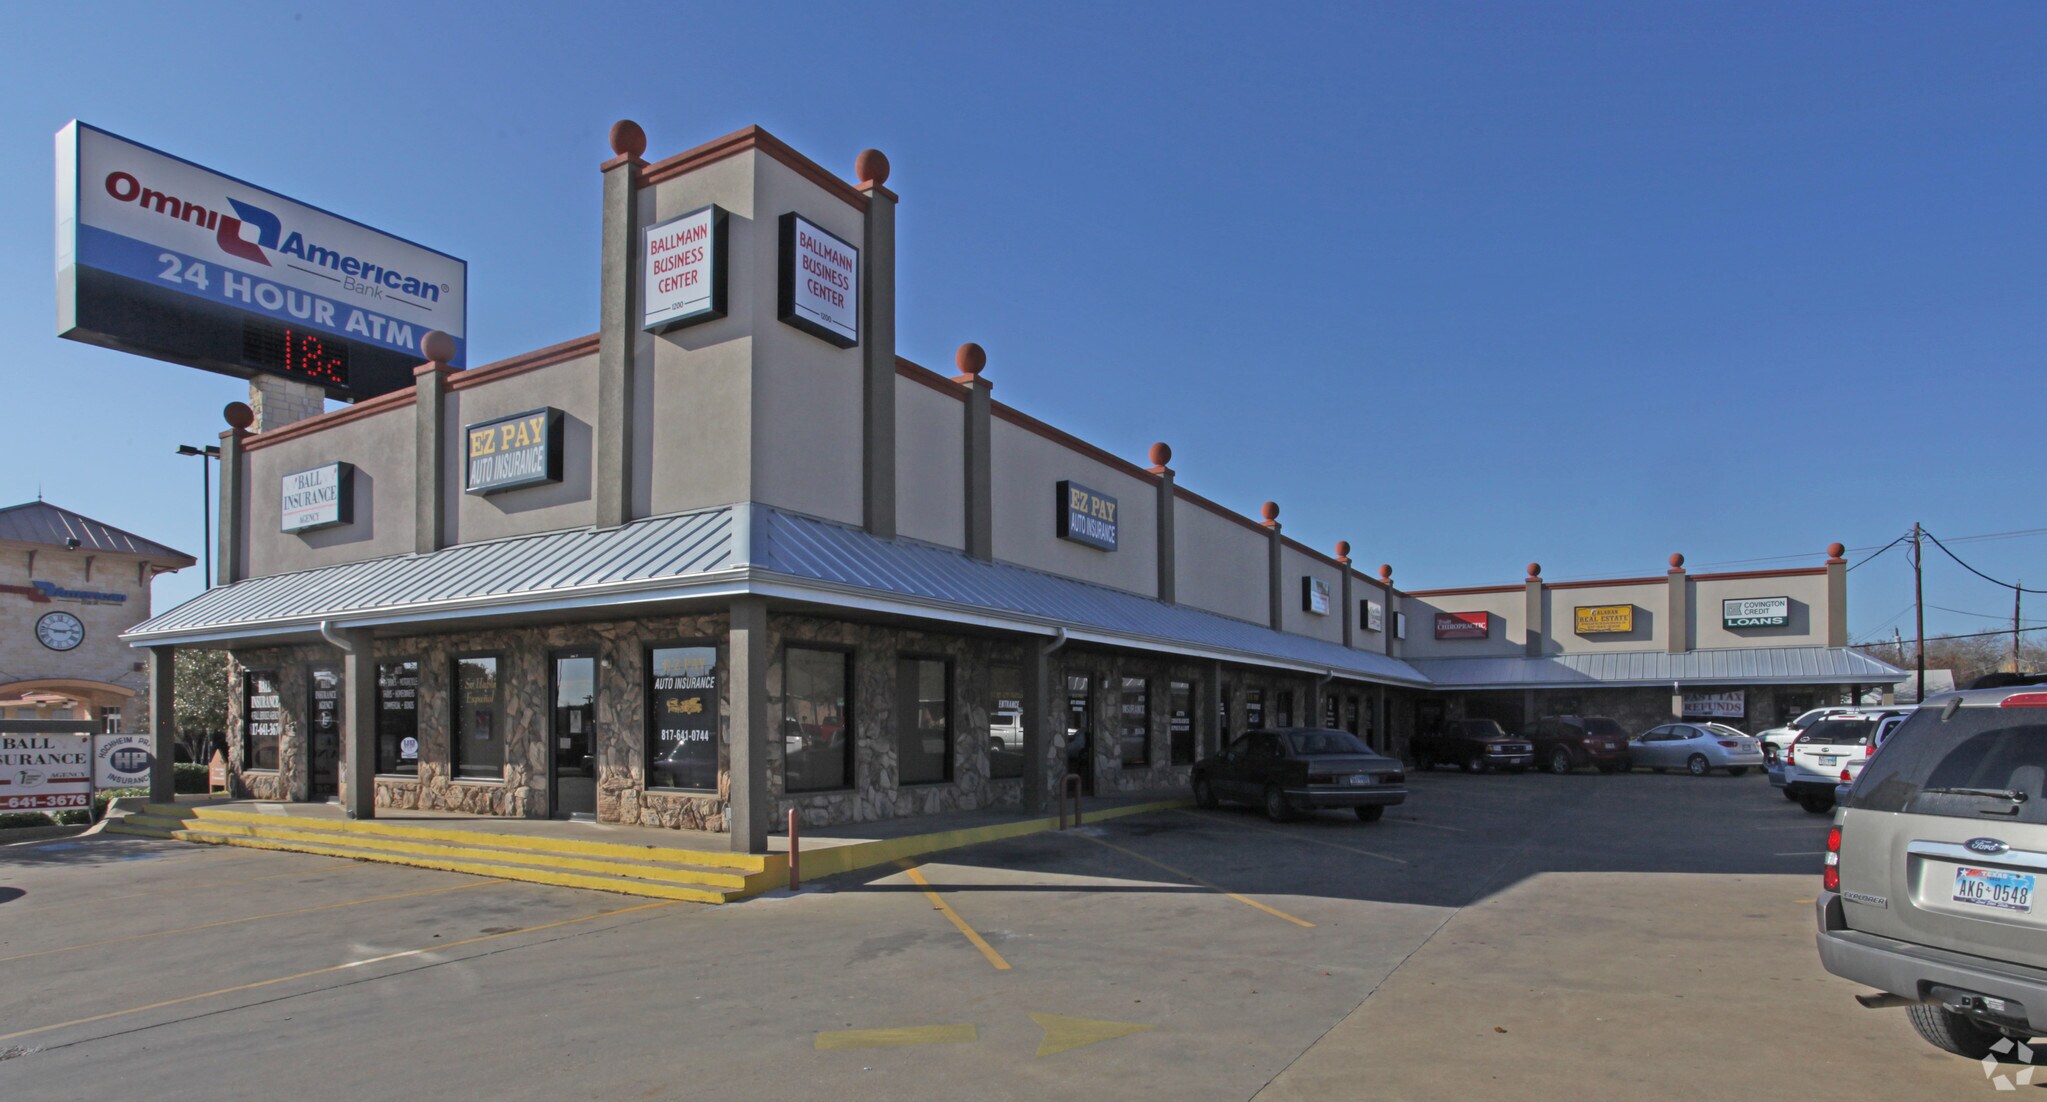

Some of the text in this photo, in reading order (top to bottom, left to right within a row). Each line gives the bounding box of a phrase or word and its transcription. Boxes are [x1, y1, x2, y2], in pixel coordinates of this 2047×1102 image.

[105, 171, 439, 302] Omni American
[651, 223, 707, 255] BALLMANN
[653, 246, 704, 276] BUSINESS
[800, 231, 852, 273] BALLMANN
[658, 269, 698, 294] CENTER
[803, 255, 849, 291] BUSINESS
[344, 276, 383, 300] Bank
[807, 279, 844, 308] CENTER
[158, 253, 415, 350] 24 HOUR ATM
[672, 301, 684, 310] 1200
[820, 312, 832, 323] 1200
[470, 417, 544, 457] EZ PAY
[470, 446, 544, 486] AUTO INSURANCE
[284, 485, 336, 511] INSURANCE
[1071, 488, 1115, 522] EZ PAY
[300, 512, 320, 523] AGENCY
[1071, 512, 1115, 543] AUTO INSURANCE
[1744, 600, 1785, 608] COVINGTON
[1437, 622, 1485, 630] CHIROPRACTIC
[1728, 617, 1783, 626] LOANS
[654, 676, 716, 689] AUTO INSURANCE
[1684, 702, 1741, 711] REFUNDS
[1718, 691, 1742, 701] TAX
[3, 738, 55, 749] BALL
[661, 729, 709, 741] 817-641-0744
[98, 737, 133, 758] HOCHHEIM
[115, 752, 147, 769] HP
[1971, 839, 1997, 851] Ford
[1981, 871, 2008, 879] TEXAS
[1844, 891, 1885, 904] EXPLORER
[1959, 879, 1984, 898] AK6
[1993, 884, 2028, 904] 0548
